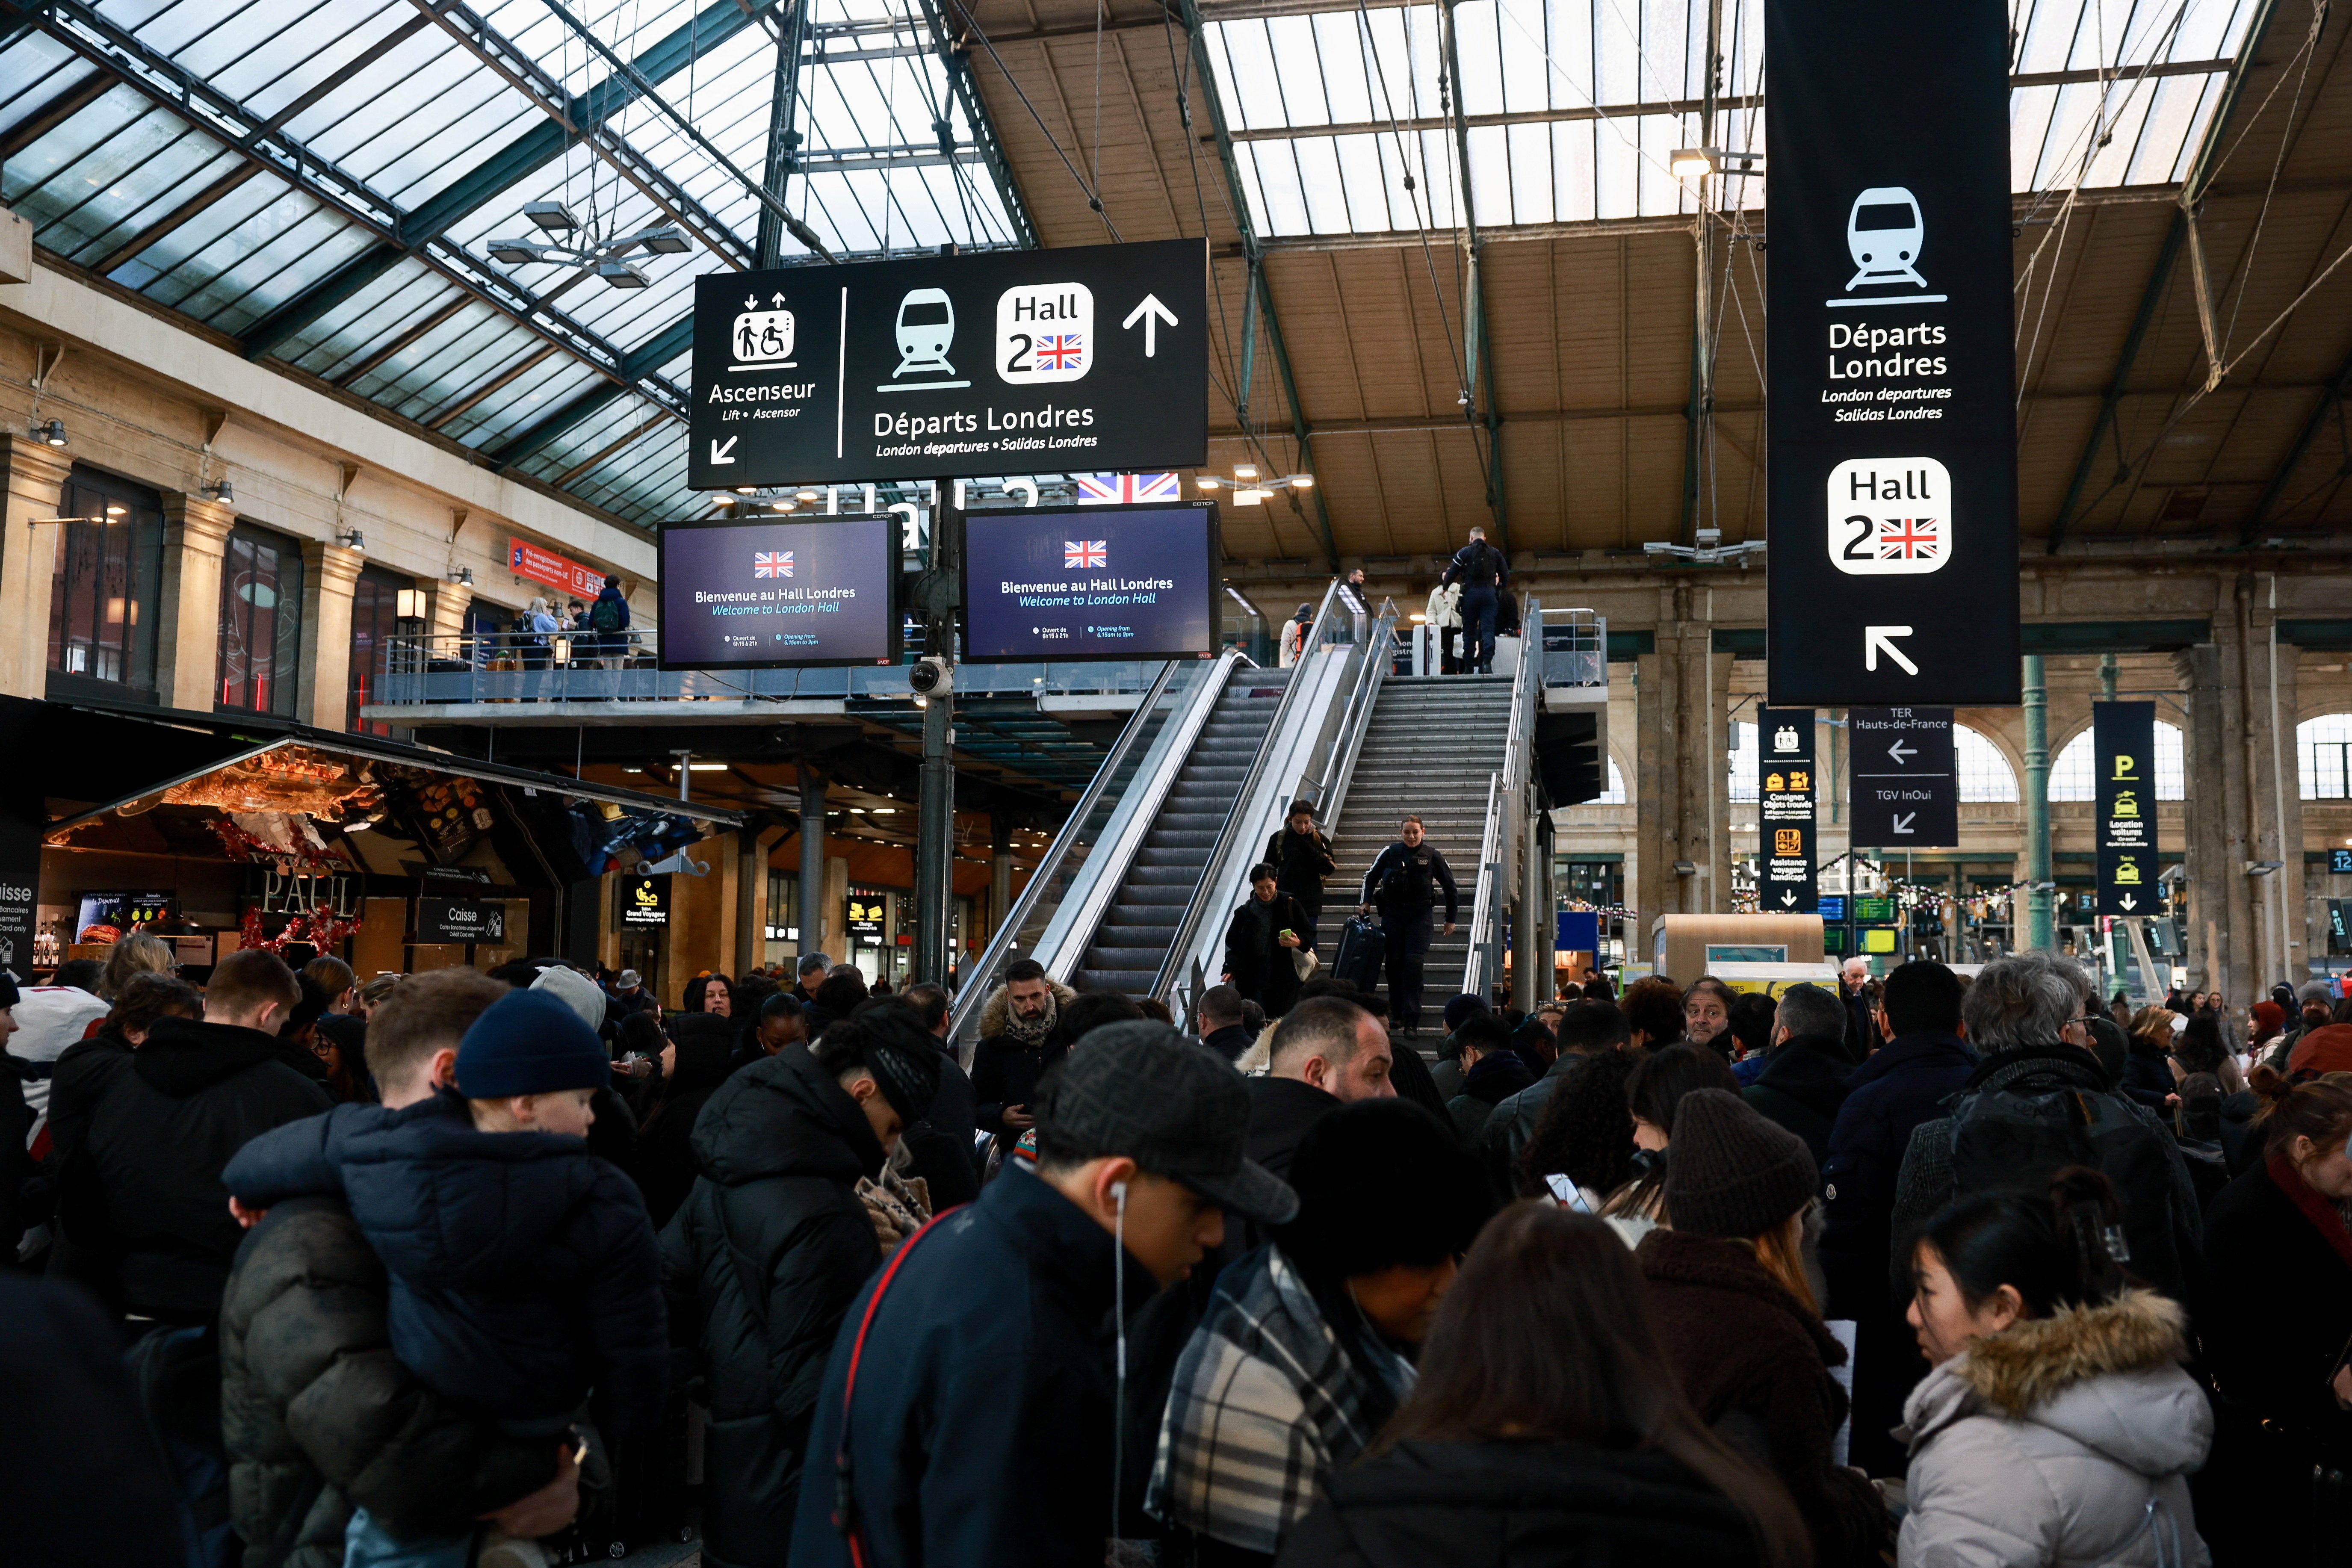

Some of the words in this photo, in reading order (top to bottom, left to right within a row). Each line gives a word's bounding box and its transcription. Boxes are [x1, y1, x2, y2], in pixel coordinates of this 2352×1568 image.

[1014, 294, 1078, 322] Hall
[1829, 322, 1947, 353] Départs
[1008, 334, 1032, 372] 2
[1829, 352, 1947, 379] Londres
[709, 380, 816, 404] Ascenseur
[1822, 388, 1873, 403] London
[1876, 386, 1952, 403] departures
[722, 409, 740, 421] Lift
[753, 406, 801, 419] Ascensor
[874, 410, 977, 439] Départs
[987, 404, 1094, 431] Londres
[1835, 408, 1885, 422] Salidas
[1887, 406, 1943, 421] Londres
[875, 441, 921, 457] London
[923, 439, 989, 457] departures
[1000, 436, 1046, 452] Salidas
[1048, 434, 1098, 449] Londres
[1850, 470, 1931, 501] Hall
[1843, 515, 1874, 560] 2
[1002, 582, 1067, 594] Bienvenue
[1071, 582, 1087, 591] au
[1090, 579, 1117, 591] Hall
[1121, 578, 1173, 590] Londres
[696, 591, 756, 603] Bienvenue
[760, 592, 774, 600] au
[779, 588, 803, 599] Hall
[807, 587, 856, 599] Londres
[1019, 596, 1070, 607] Welcome
[1073, 596, 1084, 605] to
[1087, 594, 1129, 605] London
[1132, 593, 1156, 604] Hall
[712, 605, 759, 616] Welcome
[762, 606, 772, 614] to
[776, 603, 814, 614] London
[818, 602, 839, 612] Hall
[1891, 708, 1912, 718] TER
[1857, 719, 1947, 729] Hauts-de-France
[2116, 755, 2134, 777] P
[1770, 793, 1805, 802] Consignes
[1876, 790, 1899, 800] TGV
[1902, 790, 1932, 800] InOui
[1763, 800, 1786, 810] Objets
[1786, 800, 1812, 809] trouvés
[2109, 820, 2143, 828] Location
[1770, 858, 1807, 866] Assistance
[2334, 856, 2352, 868] 12
[1770, 874, 1807, 882] handicapé
[262, 870, 356, 918] PAUL
[449, 907, 477, 922] Caisse
[14, 925, 26, 933] only
